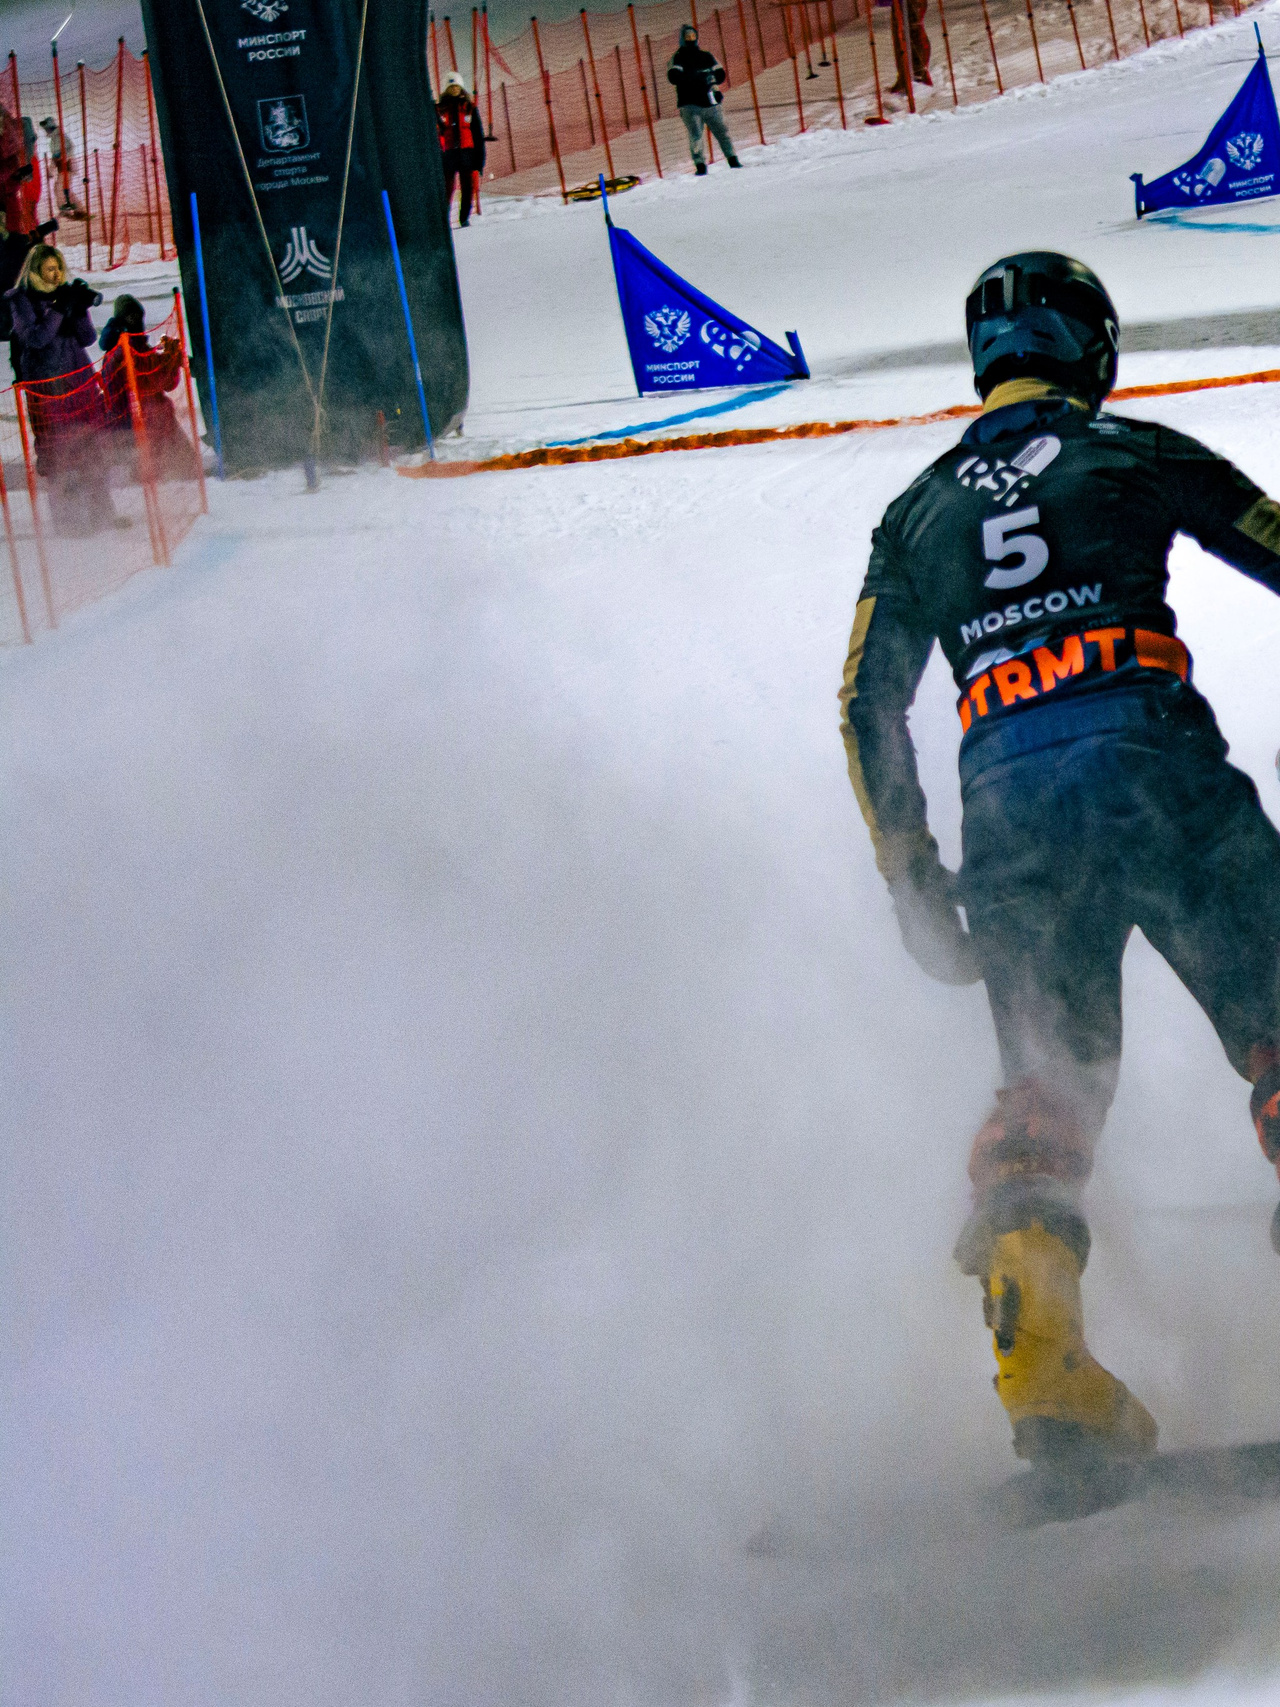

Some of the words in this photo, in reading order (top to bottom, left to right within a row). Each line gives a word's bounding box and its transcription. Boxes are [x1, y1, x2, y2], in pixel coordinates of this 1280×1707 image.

[238, 29, 307, 48] МИНСПОРТ
[248, 45, 301, 62] РОССИИ
[1229, 173, 1275, 189] МИНСПОРТ
[1235, 185, 1272, 197] РОССИИ
[646, 360, 700, 372] МИНСПОРТ
[653, 373, 695, 384] РОССИИ
[982, 506, 1049, 589] 5
[959, 583, 1103, 645] MOSCOW
